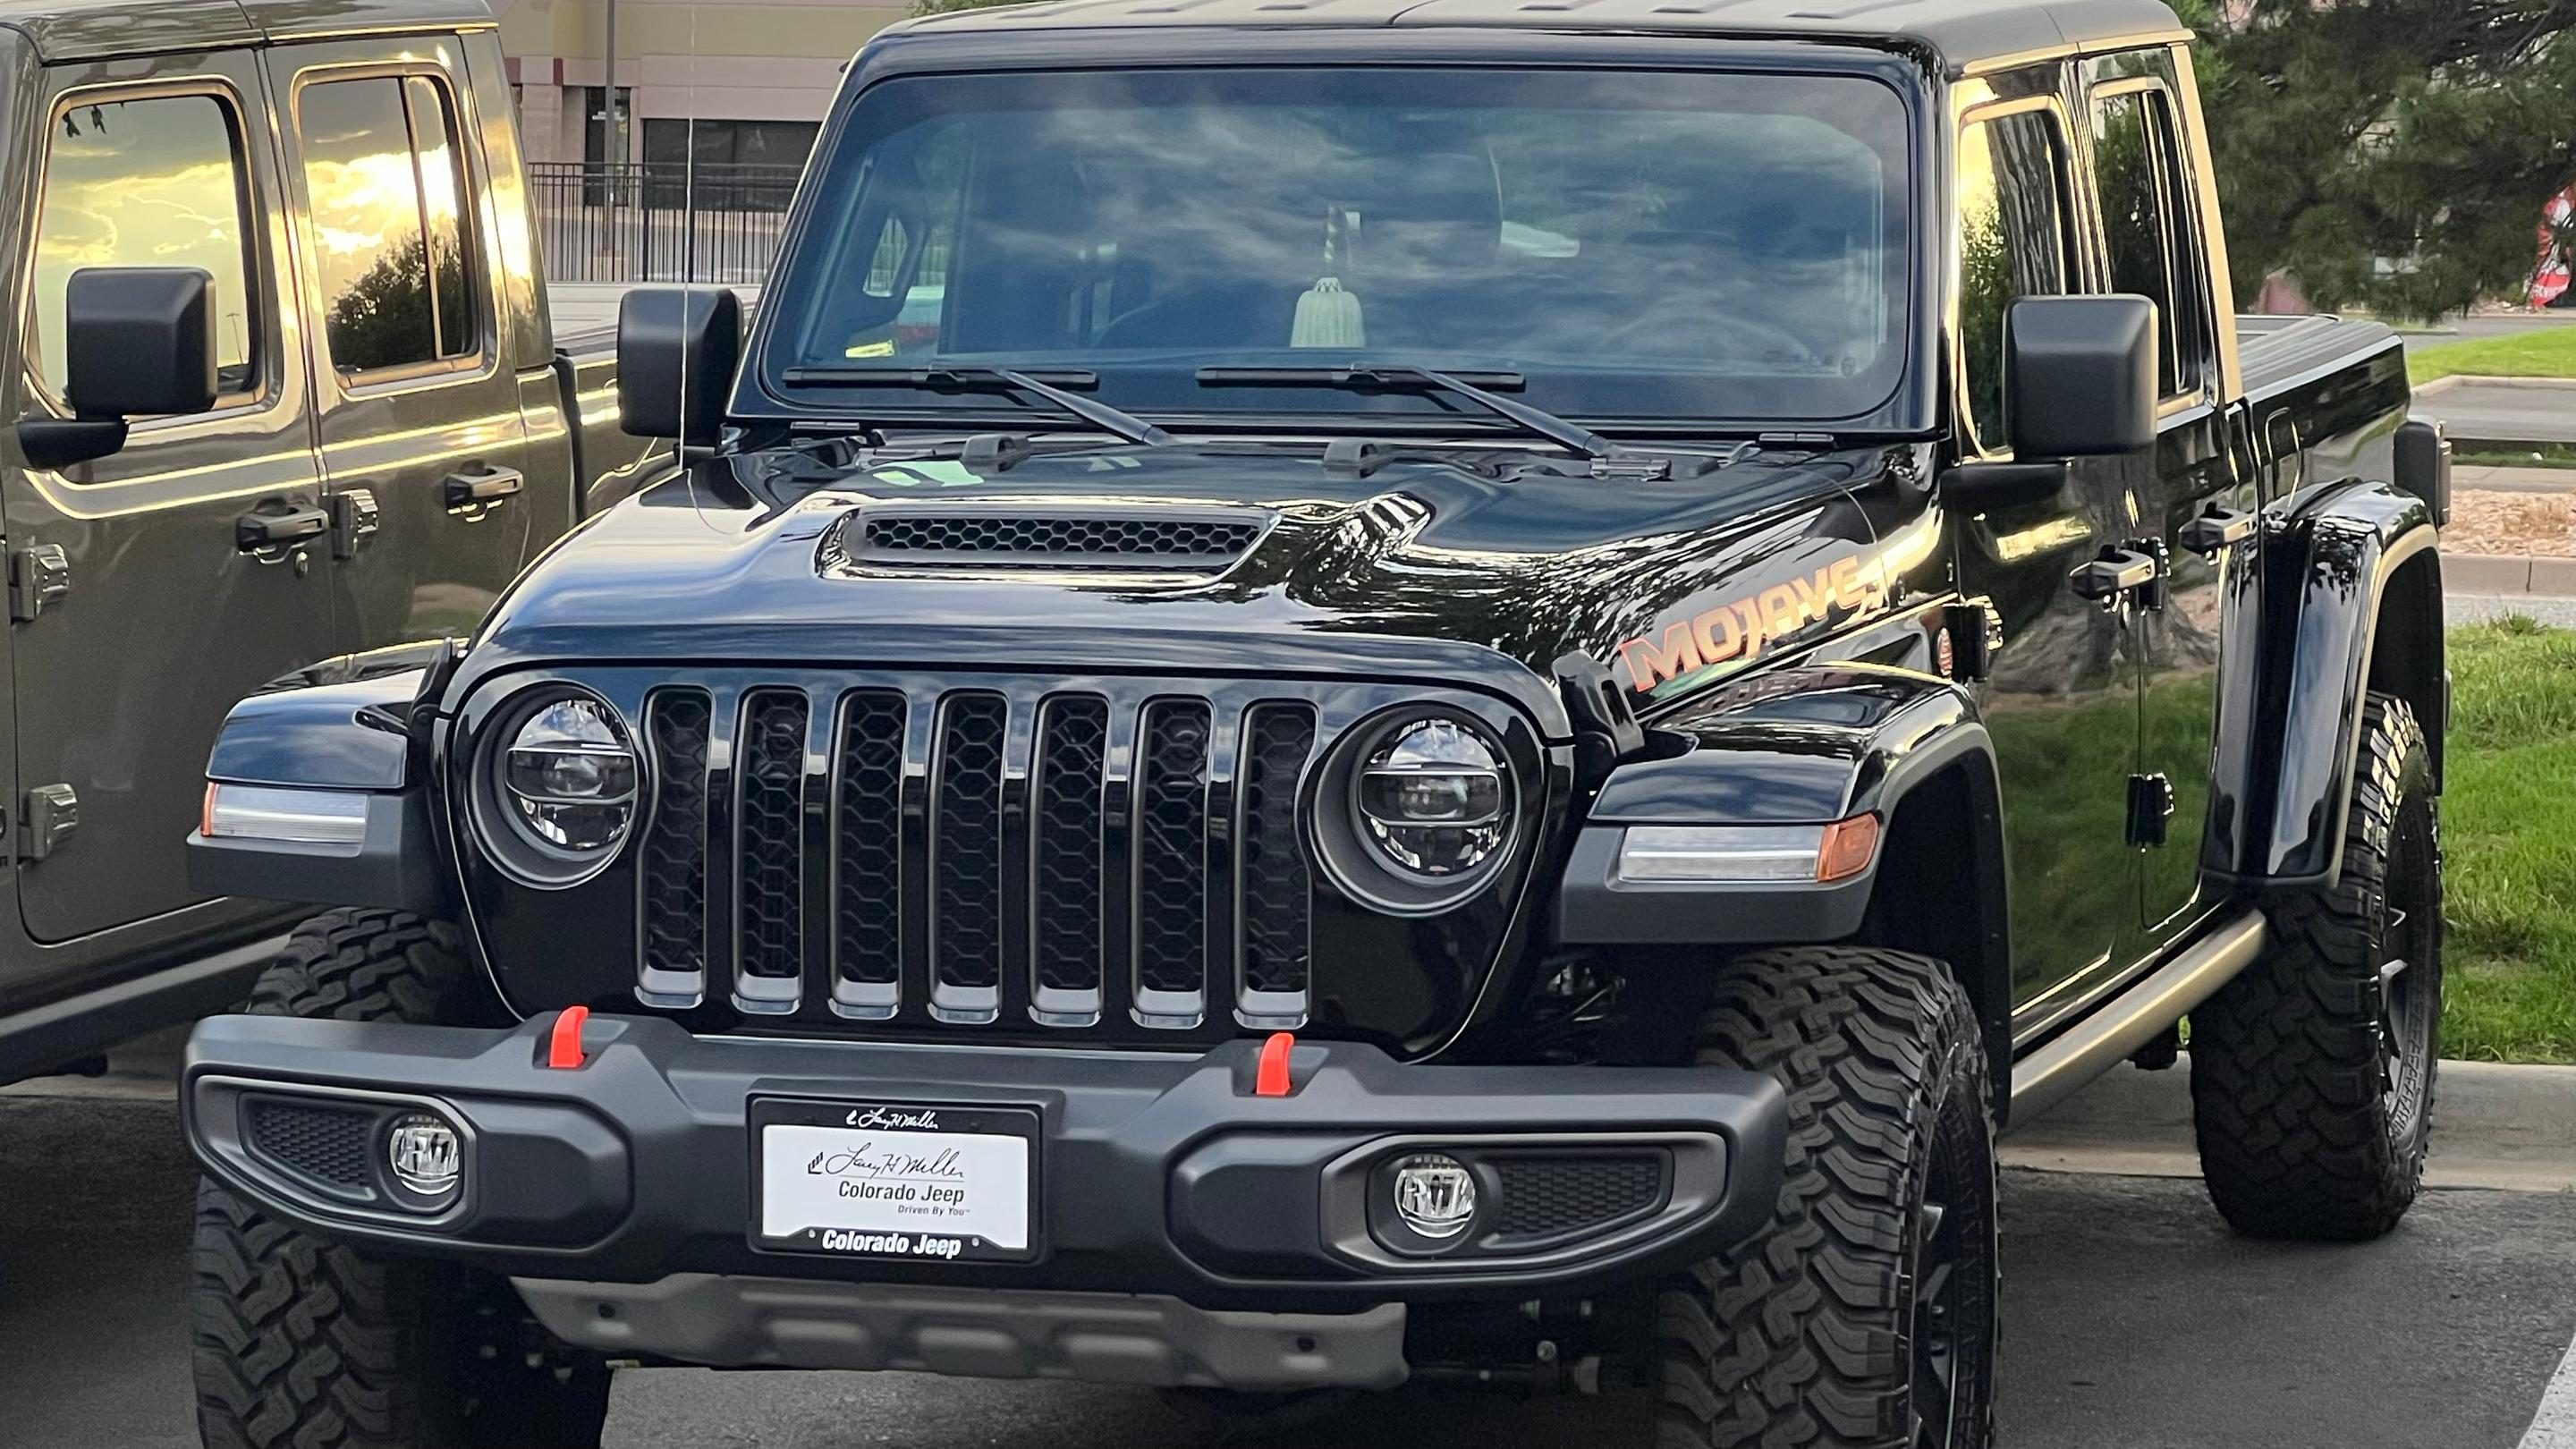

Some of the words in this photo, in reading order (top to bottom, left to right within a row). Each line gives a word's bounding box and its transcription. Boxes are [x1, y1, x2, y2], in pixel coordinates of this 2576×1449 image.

[1619, 555, 1869, 692] MOJAVE
[898, 1147, 965, 1179] Miller
[838, 1180, 916, 1201] Colorado
[920, 1184, 965, 1206] Jeep
[897, 1204, 929, 1215] Driven
[932, 1206, 945, 1216] By
[822, 1229, 910, 1253] Colorado
[912, 1233, 962, 1260] Jeep
